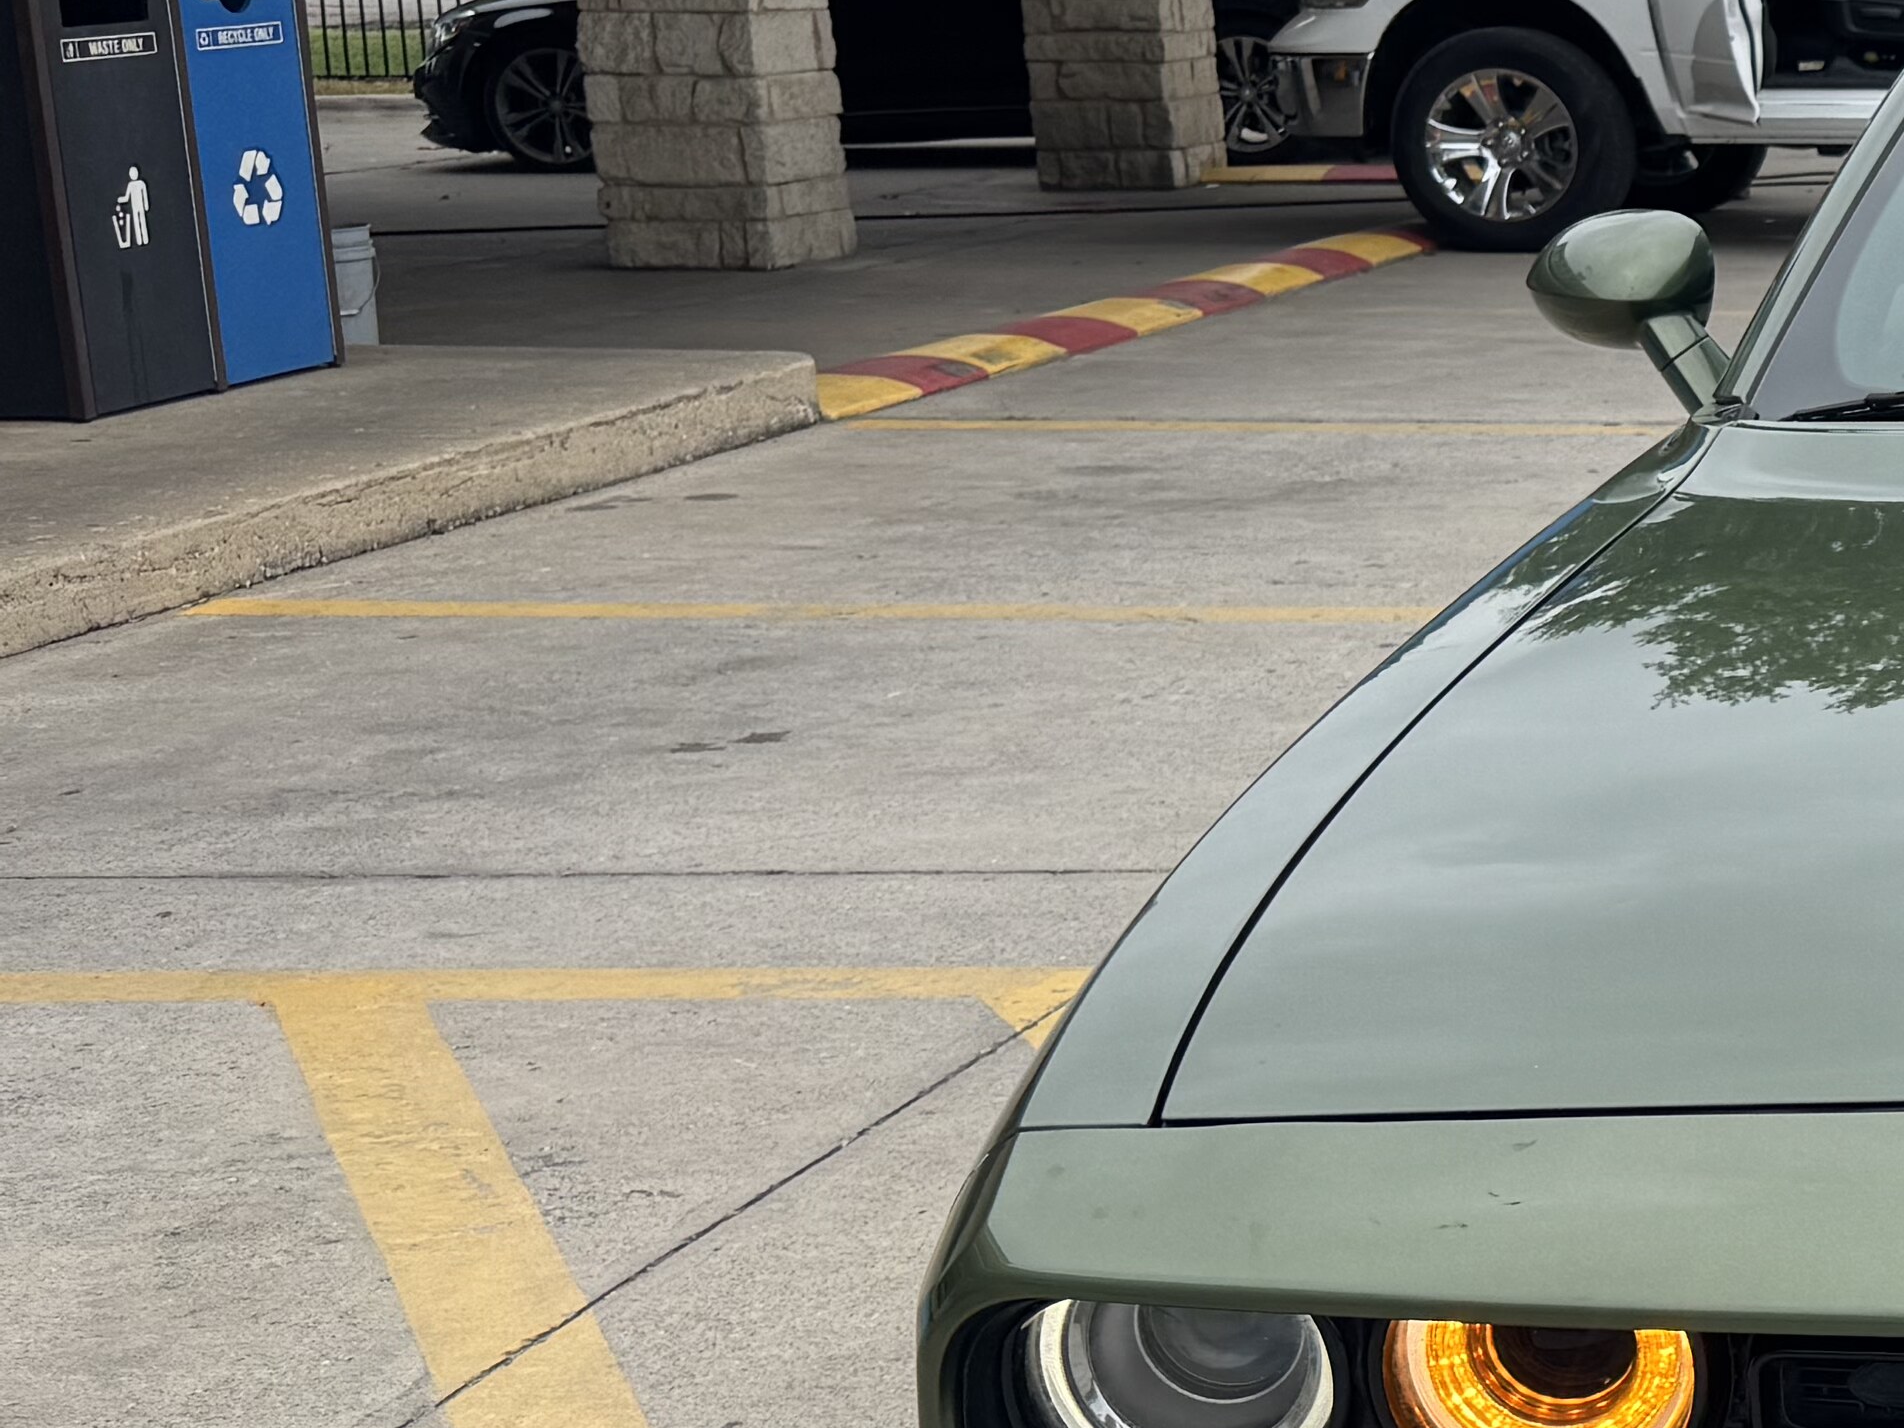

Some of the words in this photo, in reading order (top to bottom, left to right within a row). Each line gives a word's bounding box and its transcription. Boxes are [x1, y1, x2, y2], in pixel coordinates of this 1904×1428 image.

[218, 30, 253, 45] RECYCLE
[254, 26, 274, 41] ONLY
[88, 40, 120, 55] WASTE
[121, 38, 144, 53] ONLY
